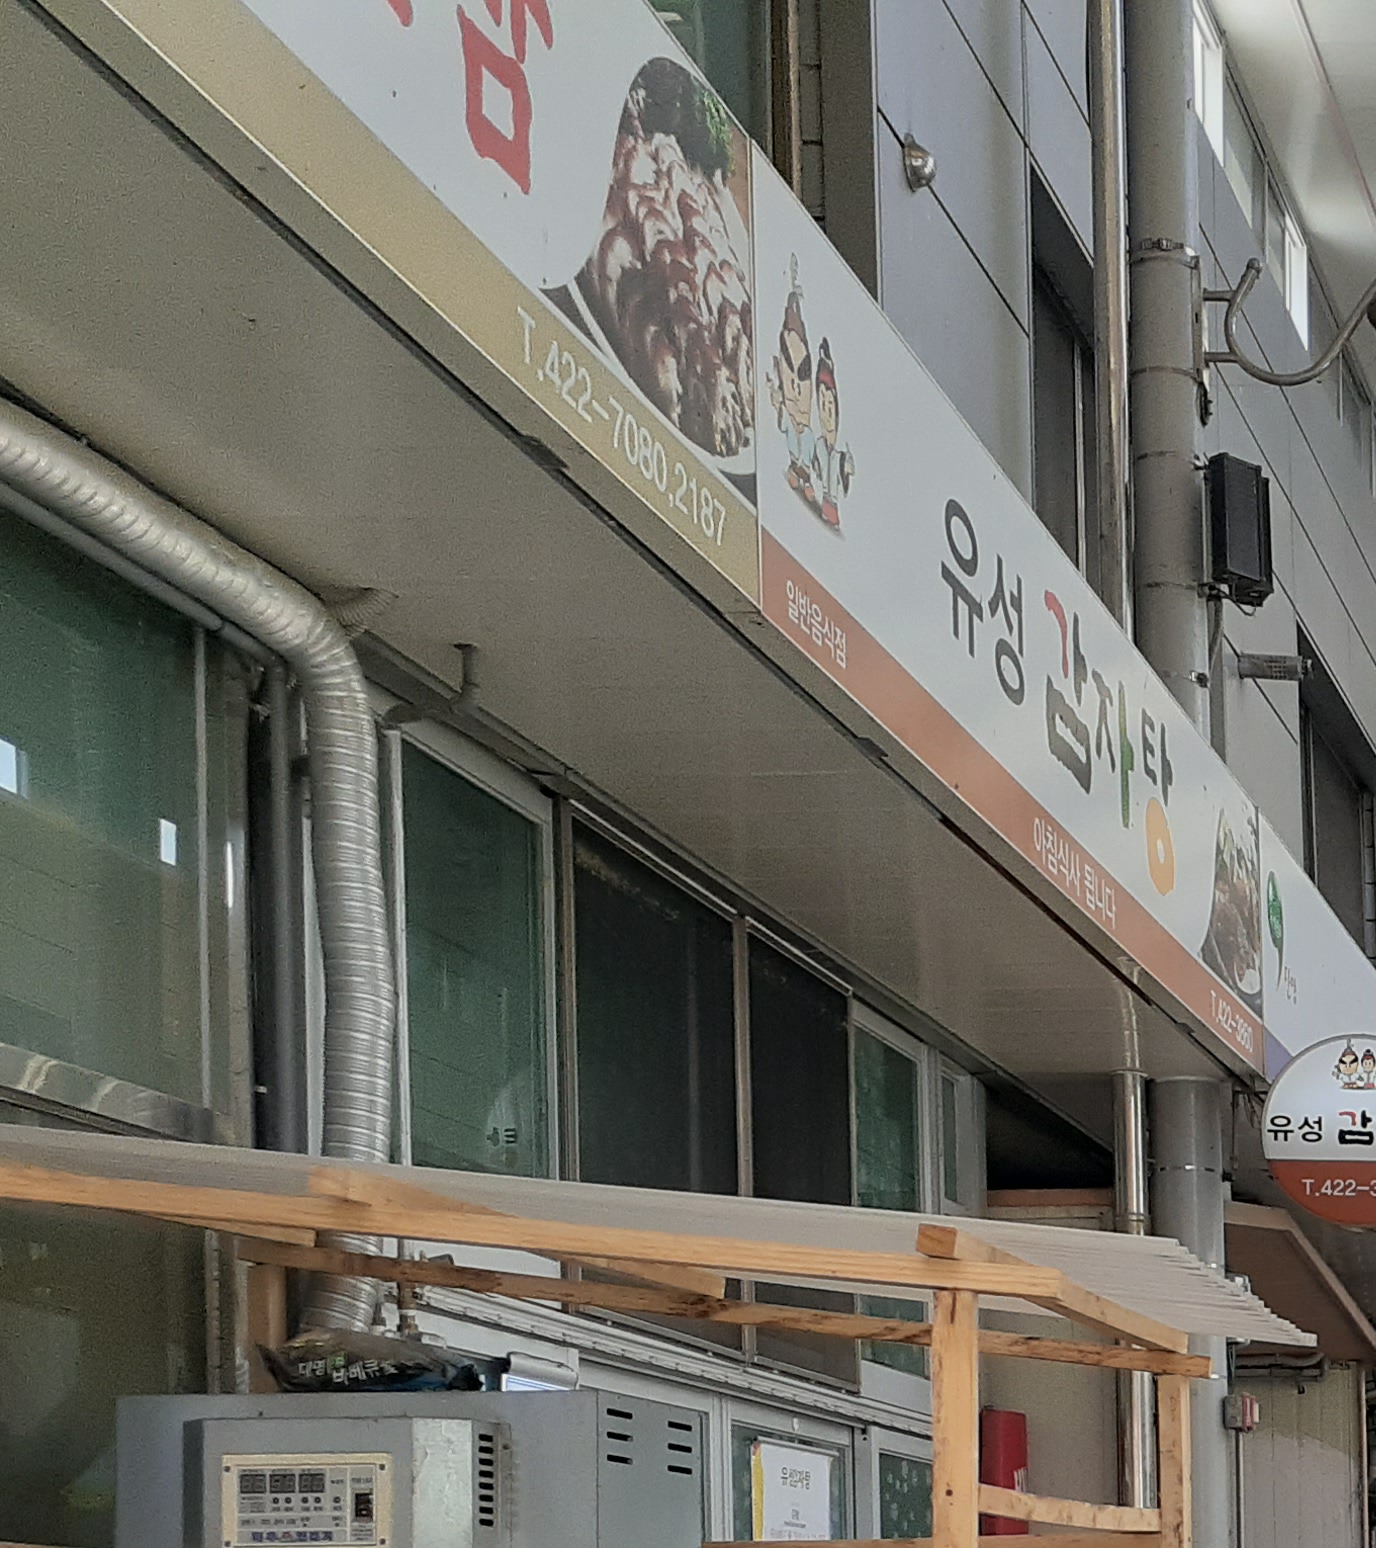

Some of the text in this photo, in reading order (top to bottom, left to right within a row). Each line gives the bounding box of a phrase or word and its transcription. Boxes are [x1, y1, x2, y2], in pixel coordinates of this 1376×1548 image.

[784, 578, 848, 670] 일반음식점
[941, 498, 1176, 897] 유성 감자탕
[1032, 817, 1117, 930] 아침식사 됩니다
[1266, 1115, 1324, 1142] 유성
